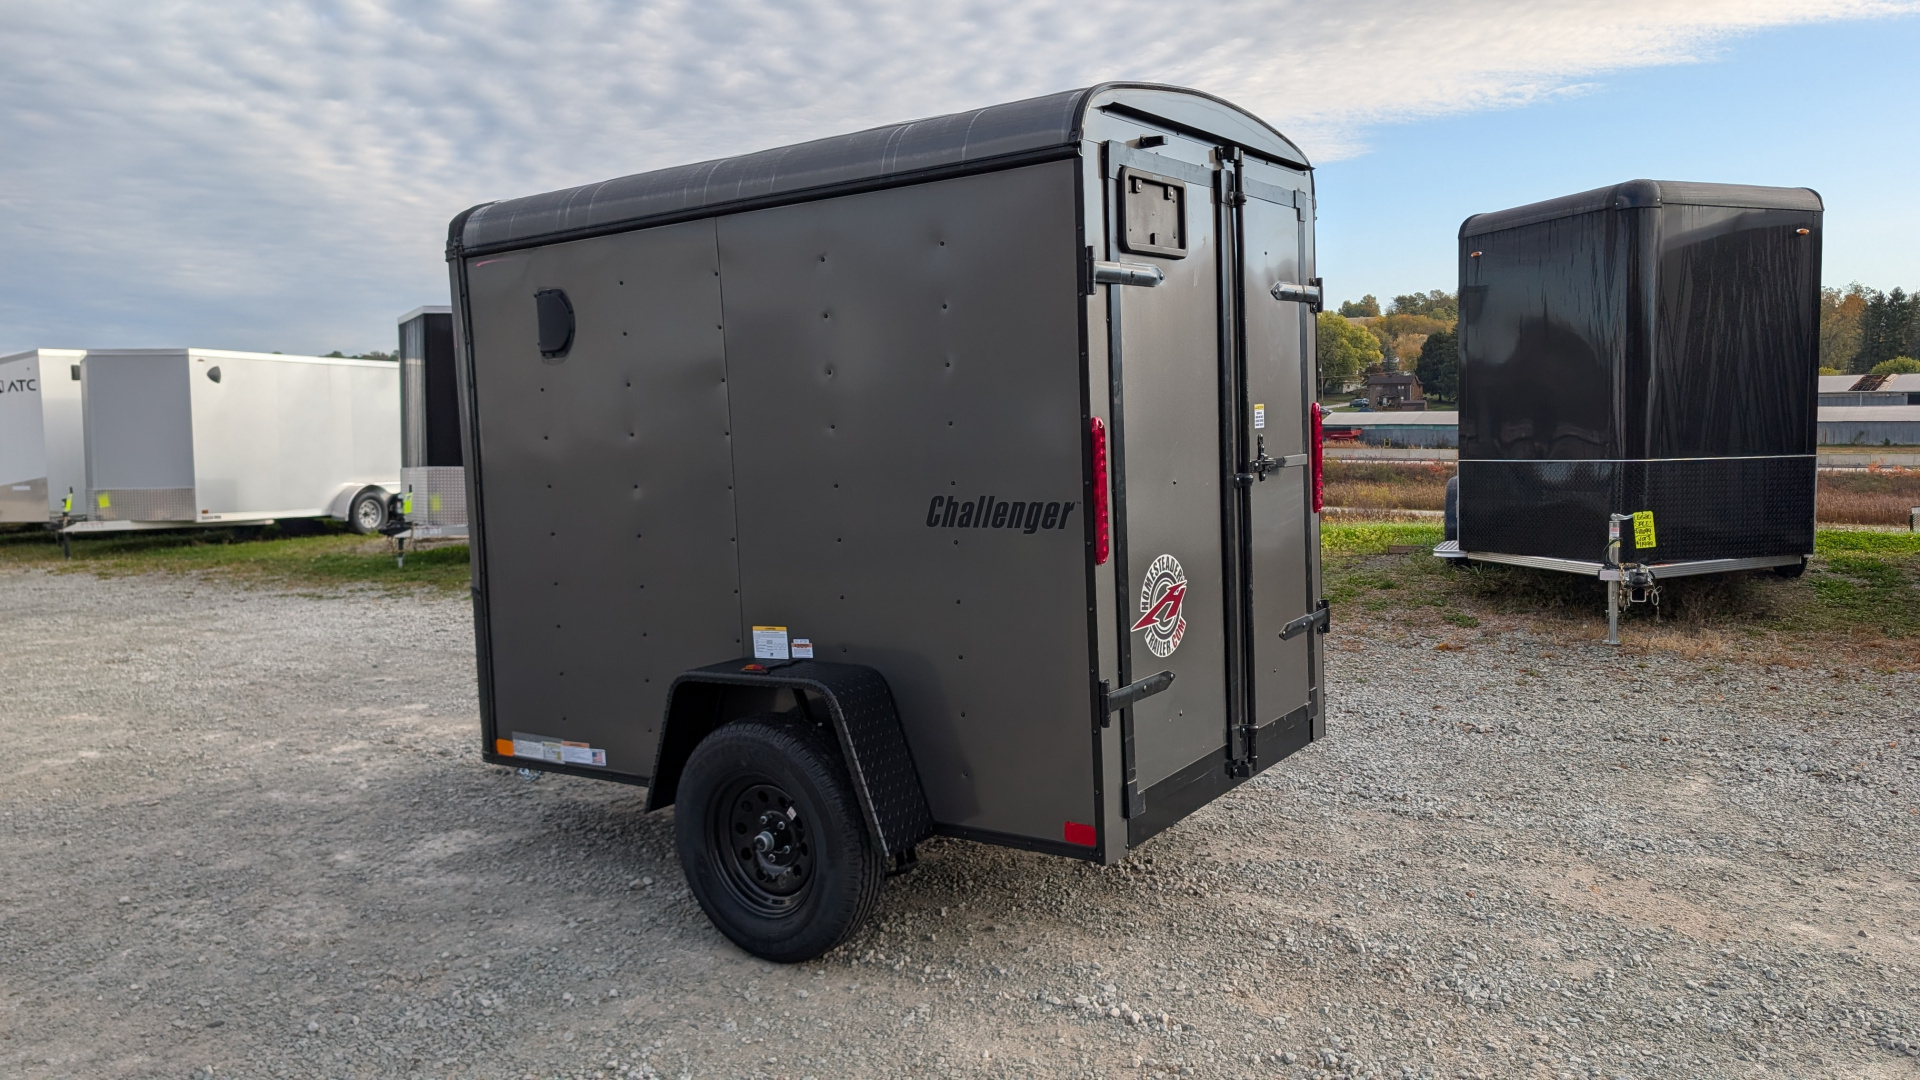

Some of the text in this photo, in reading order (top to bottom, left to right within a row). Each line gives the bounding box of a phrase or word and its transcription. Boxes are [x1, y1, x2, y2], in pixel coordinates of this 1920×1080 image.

[7, 379, 37, 392] ATC
[926, 495, 1075, 534] Challenger
[1141, 555, 1184, 611] HOMESTEADER
